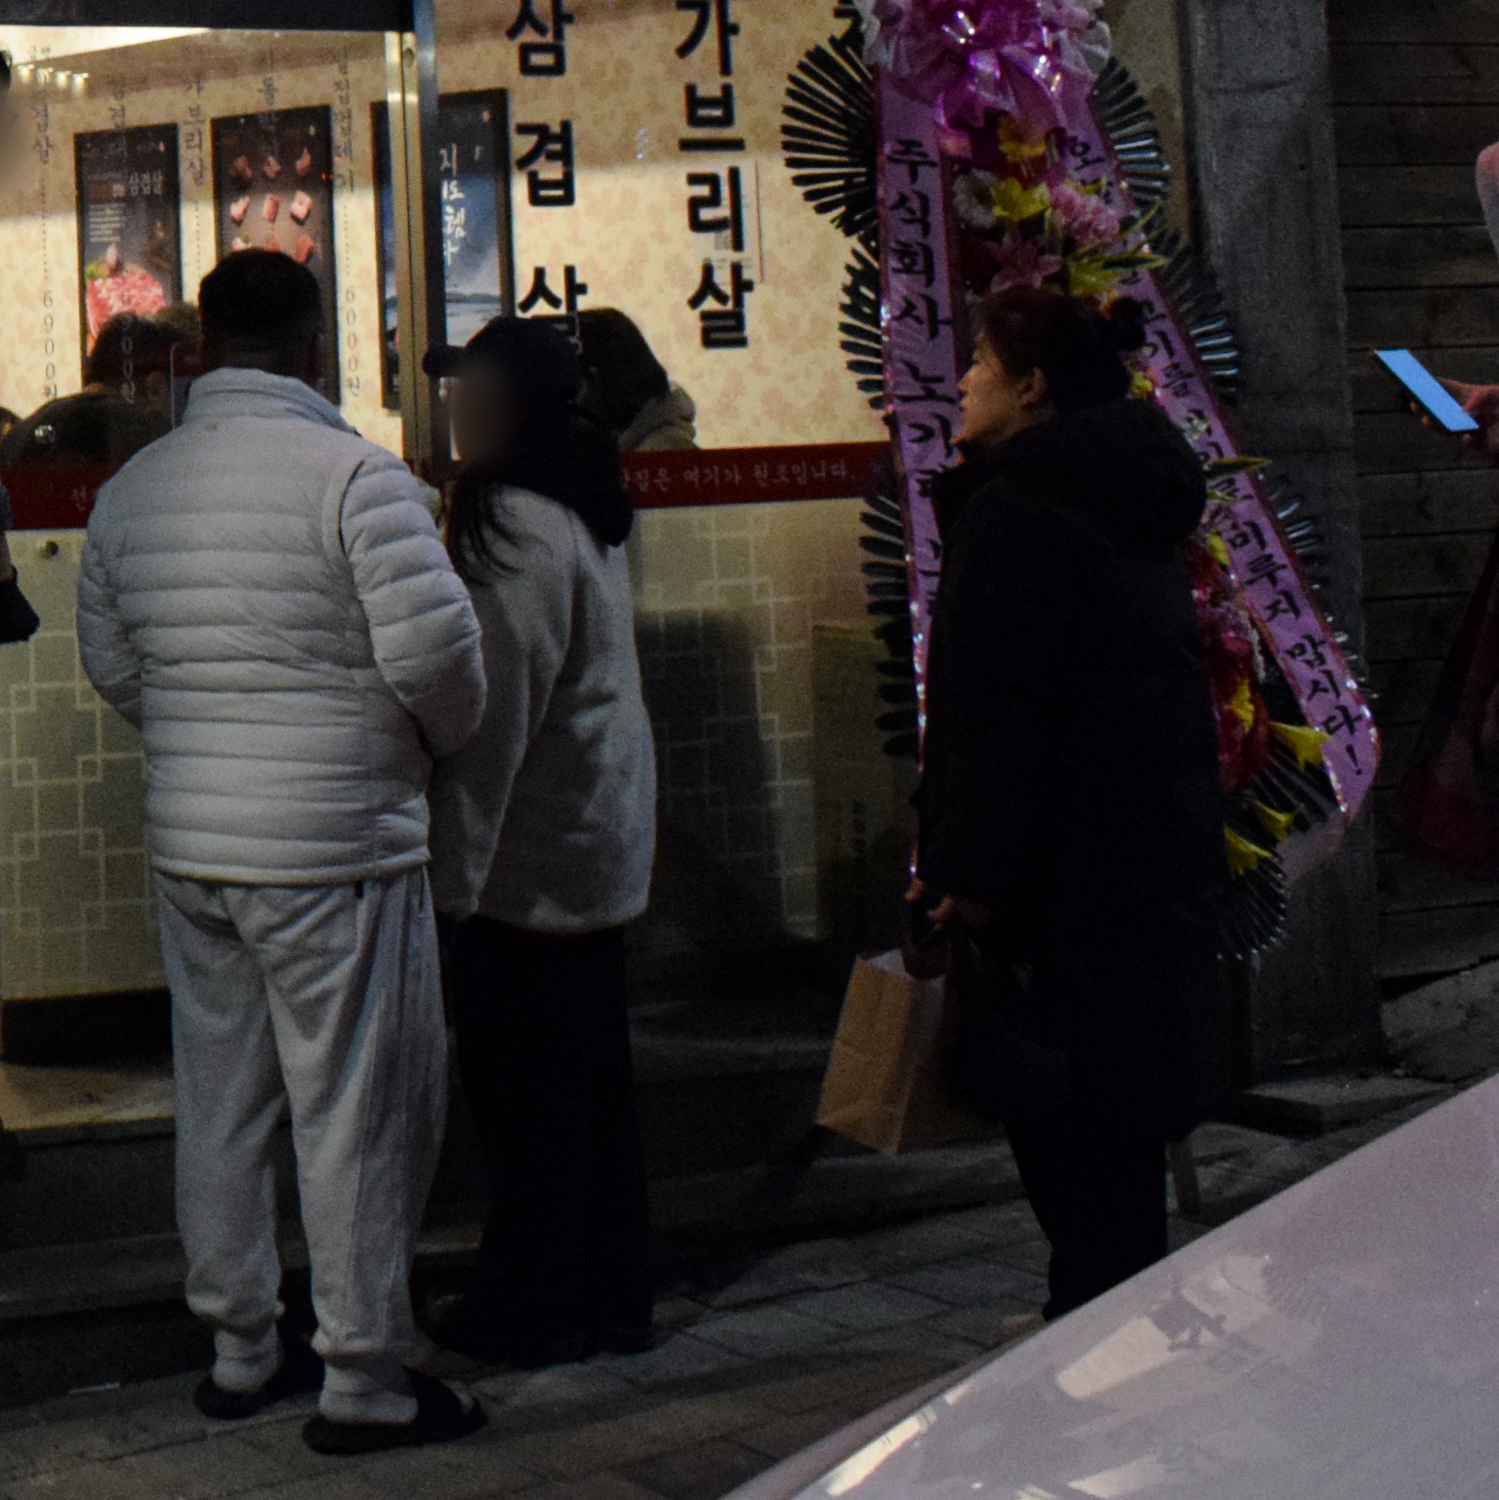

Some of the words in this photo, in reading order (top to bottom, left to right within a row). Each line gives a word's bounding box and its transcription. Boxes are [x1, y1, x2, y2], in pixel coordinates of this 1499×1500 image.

[887, 139, 952, 340] 주식회사
[681, 463, 743, 489] 여기가
[1227, 520, 1300, 622] 미루지
[1286, 633, 1362, 776] 맙시다!
